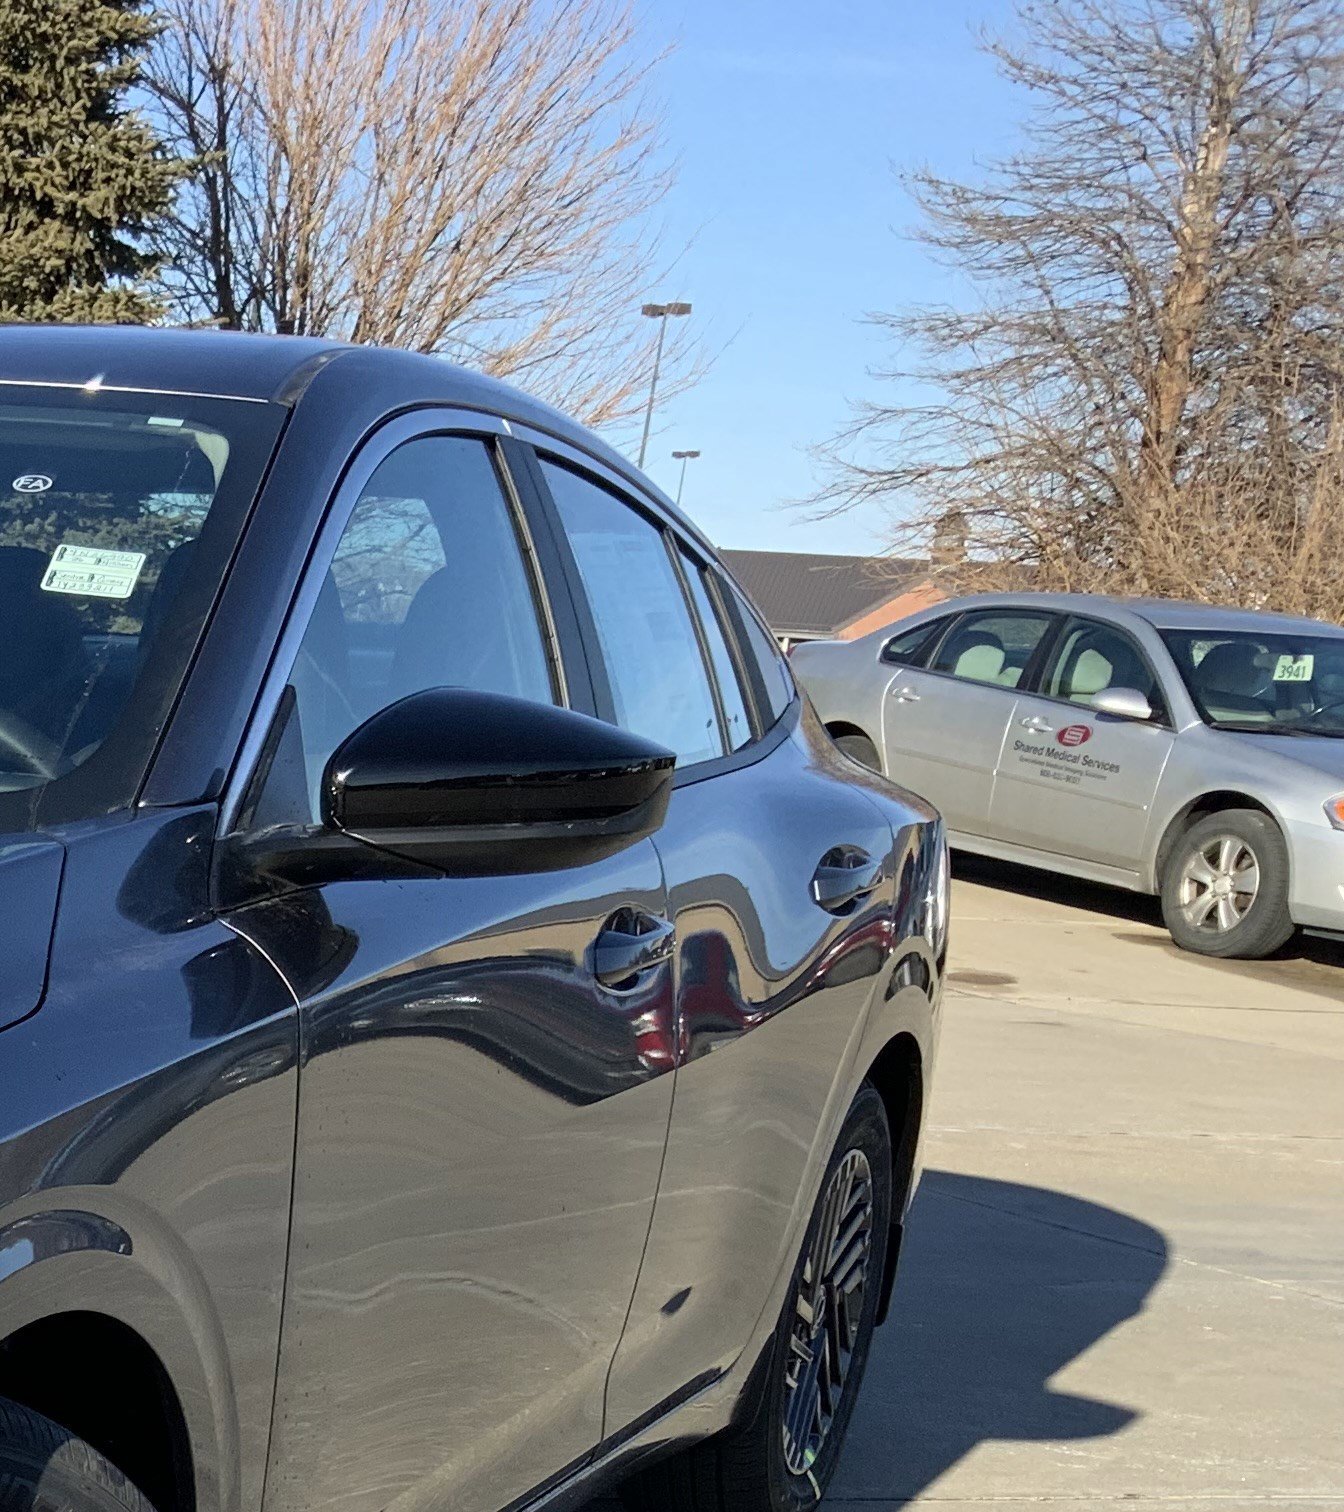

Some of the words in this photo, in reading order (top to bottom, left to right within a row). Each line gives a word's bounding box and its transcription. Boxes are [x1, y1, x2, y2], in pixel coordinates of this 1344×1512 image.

[1277, 664, 1306, 679] 3941
[1013, 740, 1045, 756] Shared
[1044, 747, 1081, 764] Medical
[1081, 755, 1121, 774] Services
